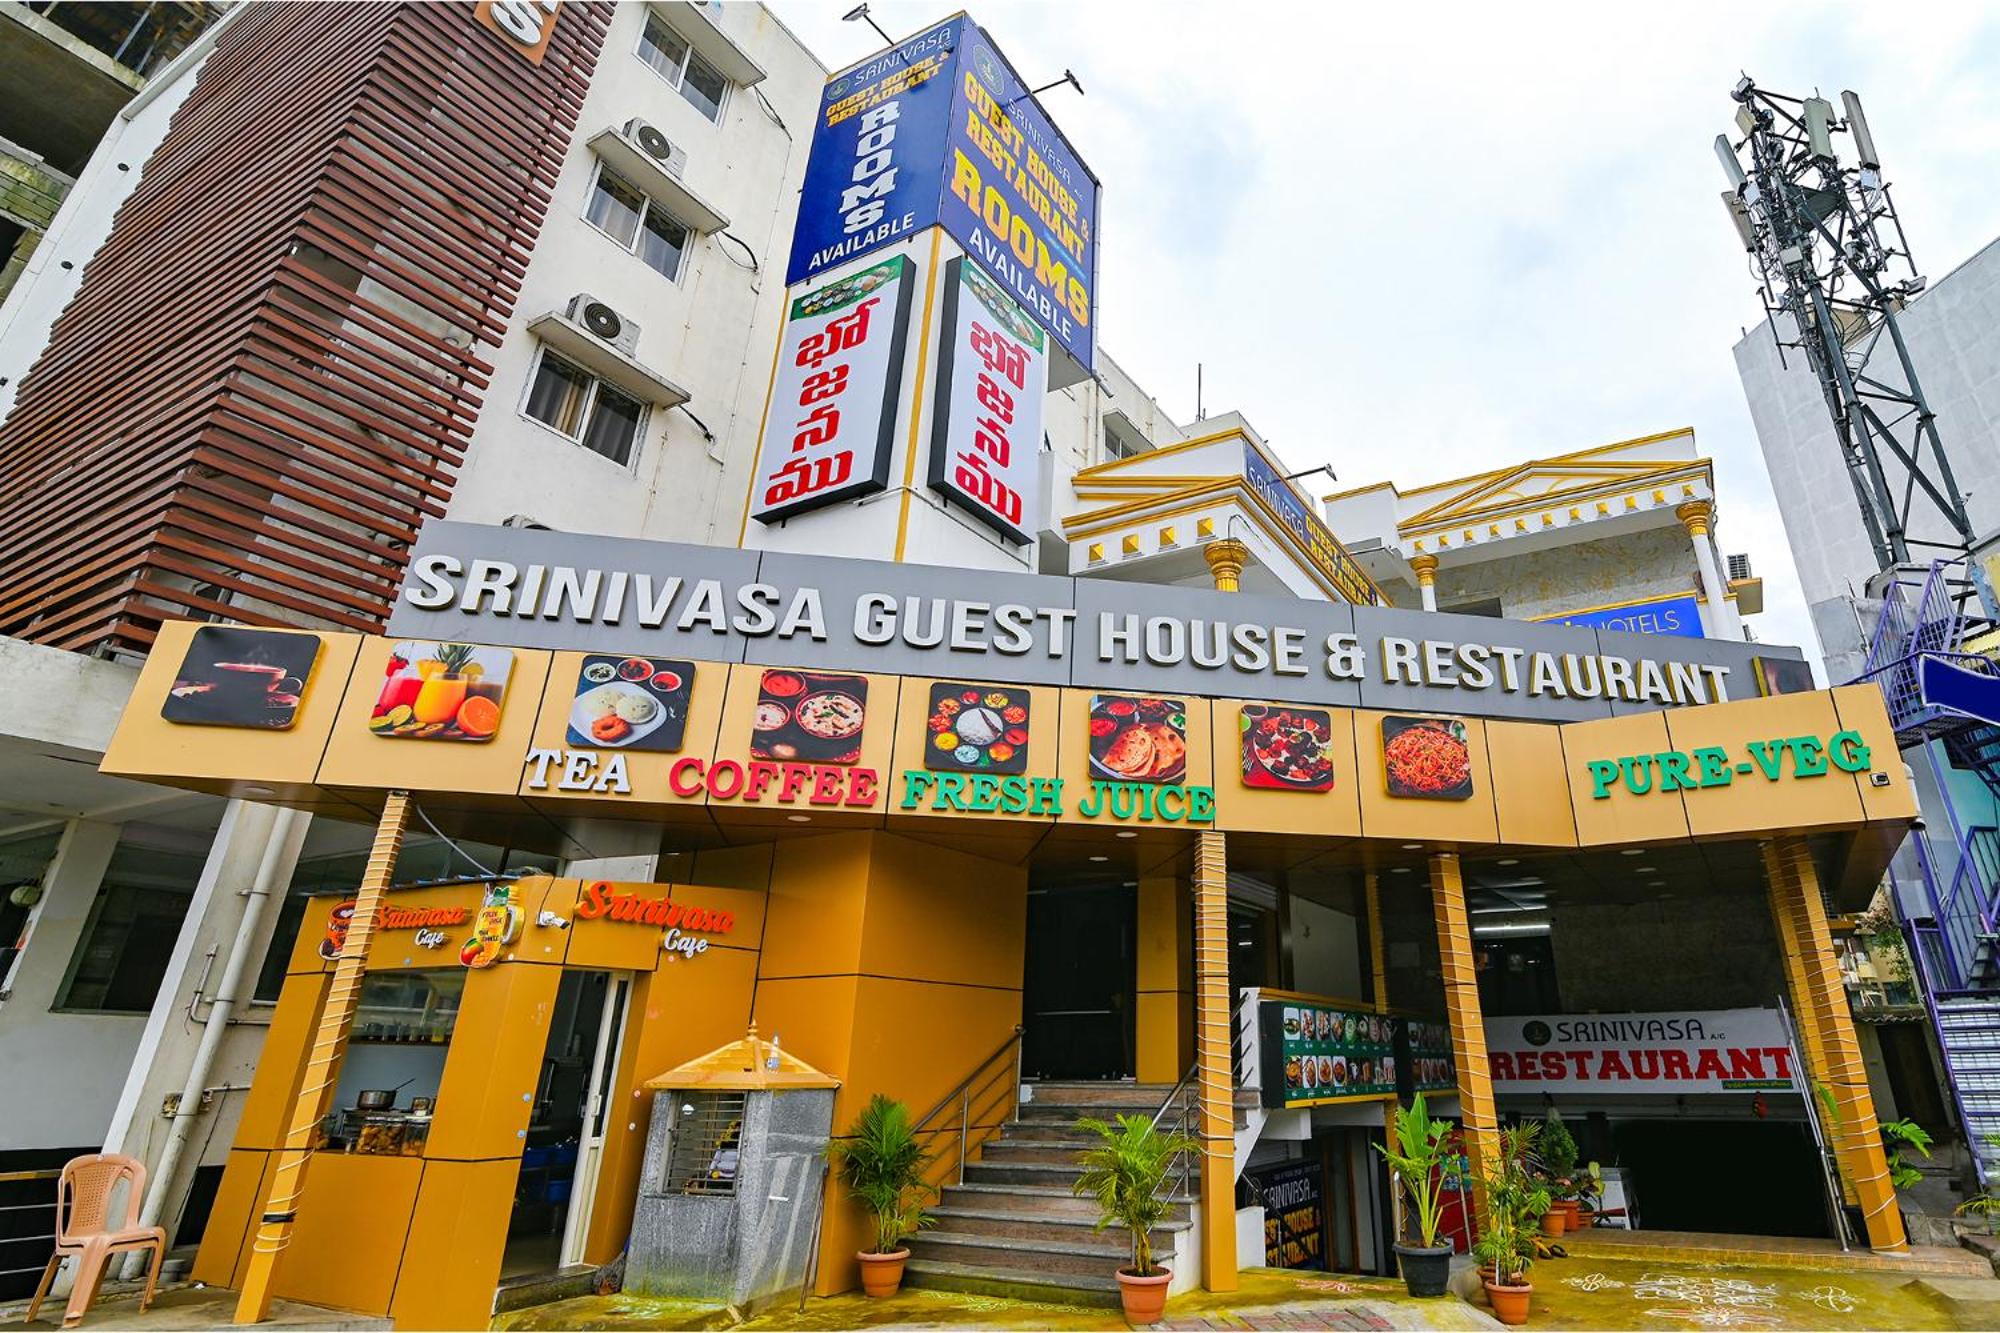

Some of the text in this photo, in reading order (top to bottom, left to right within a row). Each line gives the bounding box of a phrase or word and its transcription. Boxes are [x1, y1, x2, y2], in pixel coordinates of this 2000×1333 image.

[826, 83, 878, 118] GUEST
[881, 55, 936, 91] HOUSE
[854, 27, 951, 86] SRINIVASA
[827, 62, 943, 128] RESTAURANT
[838, 100, 900, 234] ROOMS
[964, 71, 1025, 157] GUEST
[1026, 144, 1078, 226] HOUSE
[1007, 98, 1071, 185] SRINIVASA
[966, 108, 1085, 265] RESTAURANT
[808, 211, 915, 271] AVAILABLE
[951, 147, 1089, 328] ROOMS
[969, 226, 1073, 343] AVAILABLE
[404, 554, 1731, 705] SRINIVASA GUEST HOUSE & RESTAURANT
[1599, 610, 1681, 634] OTELS
[525, 747, 1217, 823] TEA COFFEE FRESH JUICE
[1586, 730, 1873, 800] PURE-VEG
[415, 929, 445, 949] Cafe
[576, 881, 735, 933] Srinivasa
[664, 928, 709, 958] Cafe
[1557, 1018, 1705, 1043] SRINIVASA
[1489, 1047, 1792, 1081] RESTAURANT
